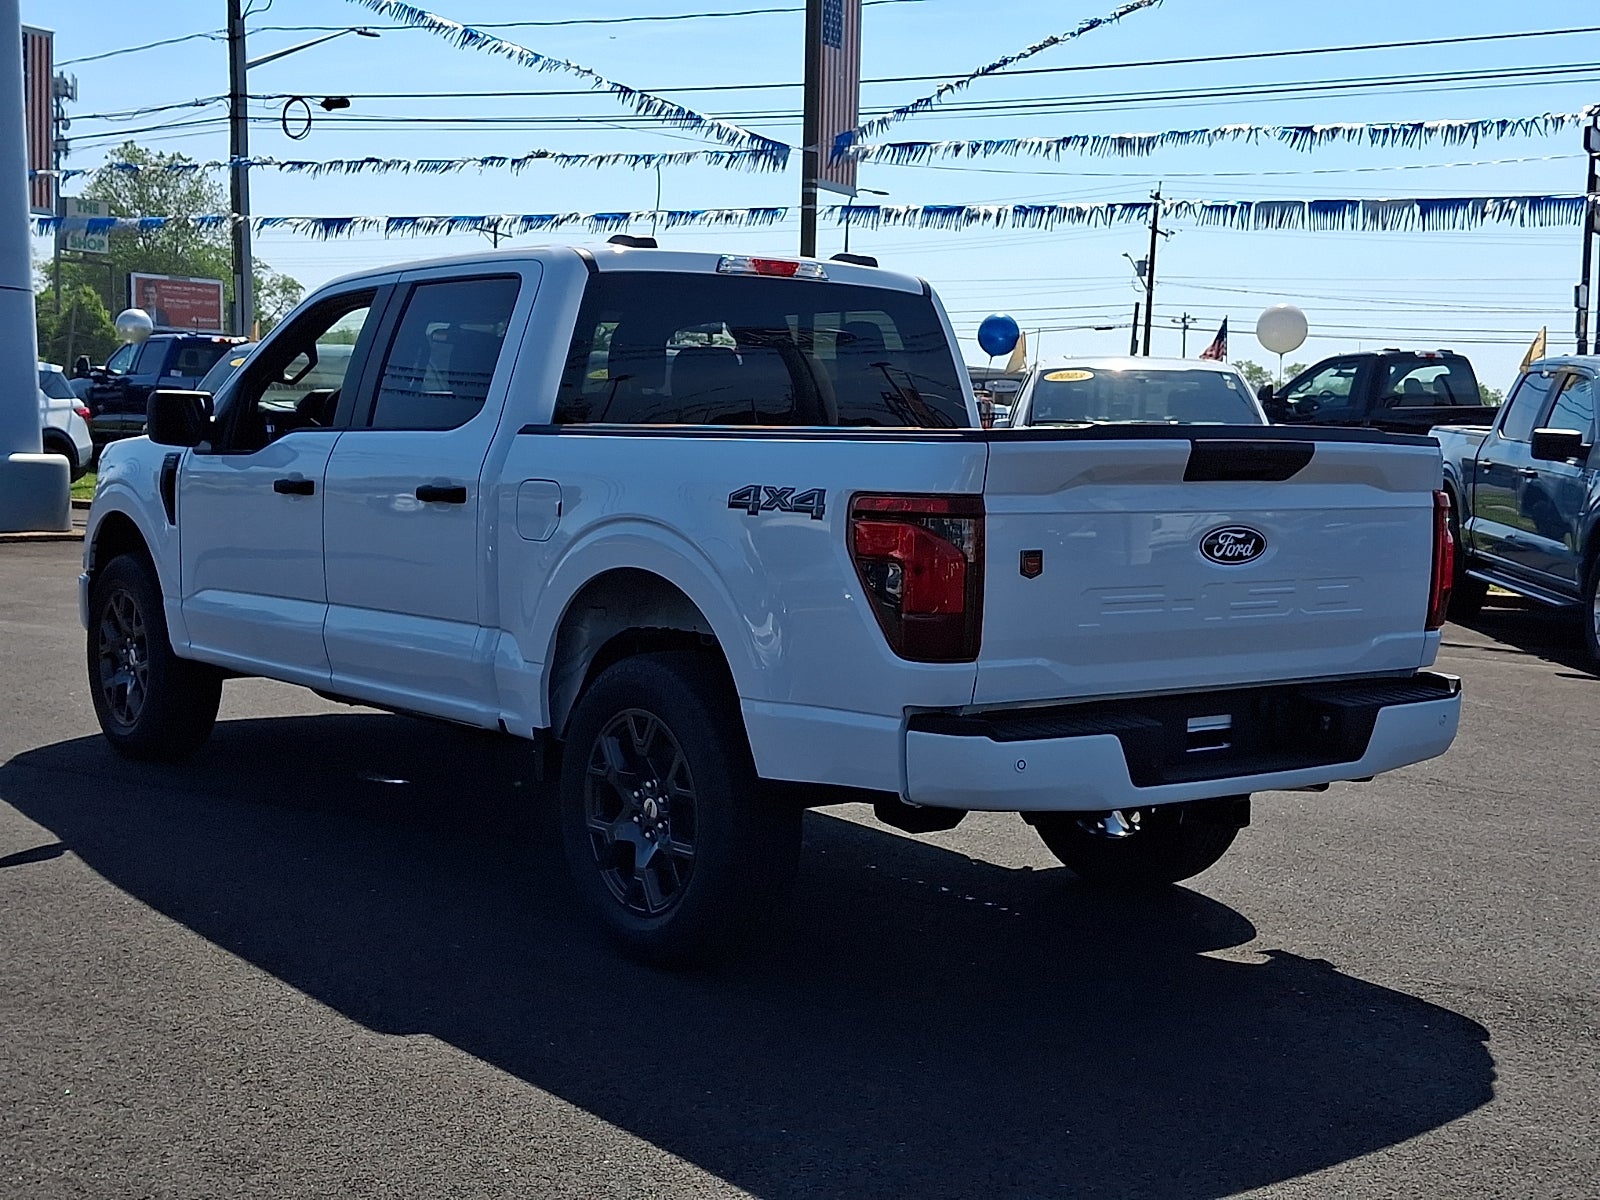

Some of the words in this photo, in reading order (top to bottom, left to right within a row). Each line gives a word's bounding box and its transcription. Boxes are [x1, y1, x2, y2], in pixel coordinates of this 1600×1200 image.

[76, 200, 99, 214] THE
[70, 235, 105, 250] SHOP
[1214, 532, 1255, 557] Ford
